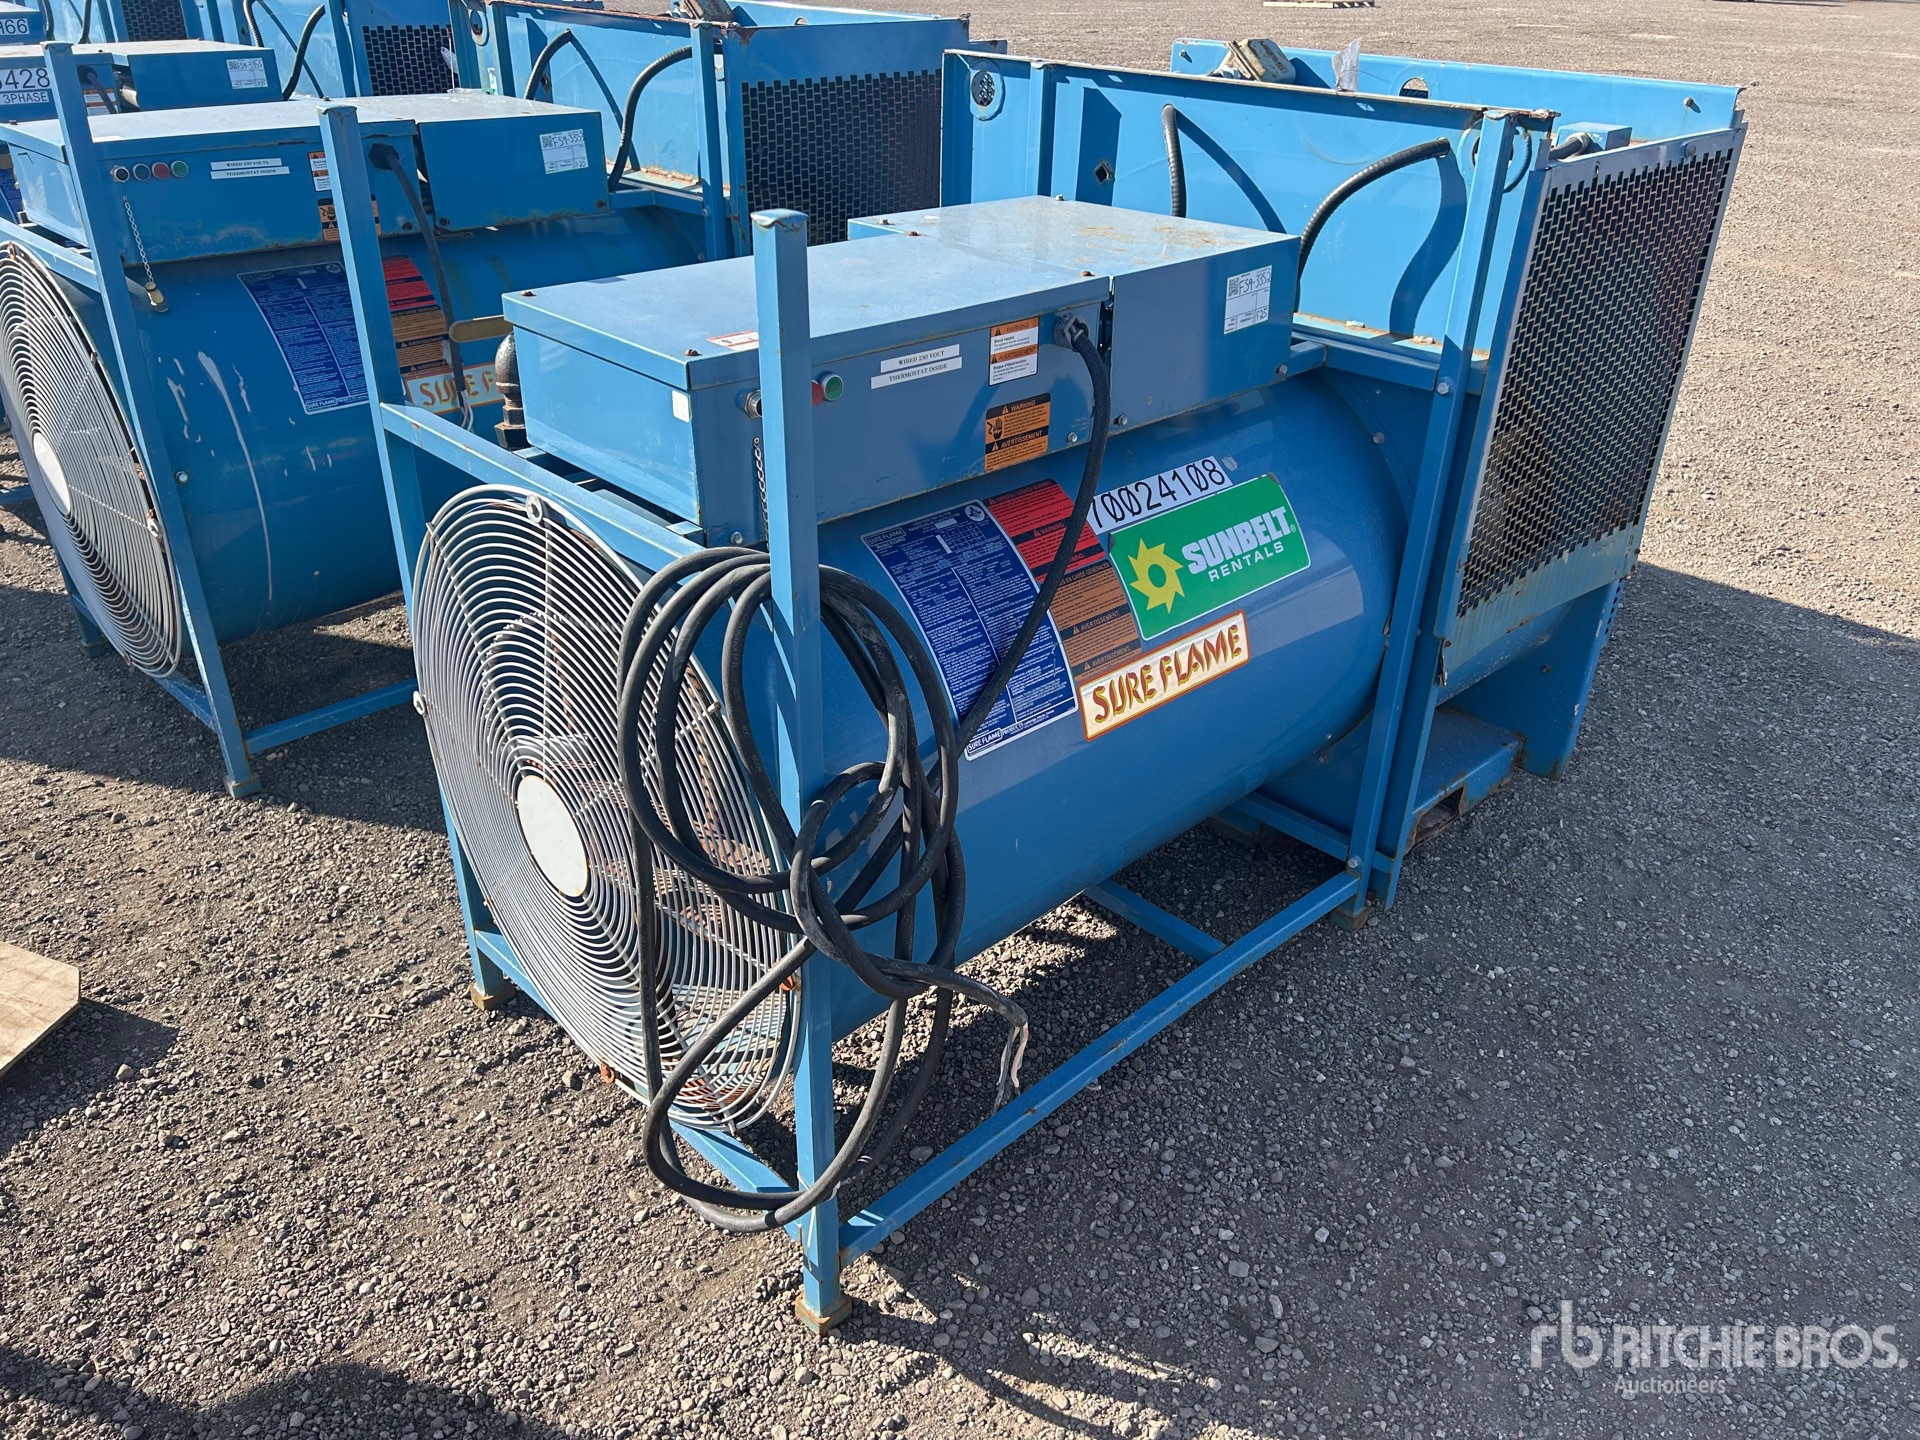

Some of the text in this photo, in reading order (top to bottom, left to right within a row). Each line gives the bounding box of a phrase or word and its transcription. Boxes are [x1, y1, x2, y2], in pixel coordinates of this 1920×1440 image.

[0, 68, 51, 89] 428
[3, 91, 48, 104] 3PHASE
[1006, 321, 1030, 332] WARNING
[898, 350, 945, 366] WIRED 230 VOLT
[999, 346, 1036, 361] AVERTISSEMENT
[889, 367, 928, 382] THERMOSTAT
[420, 374, 479, 406] SUE
[1011, 400, 1035, 412] WARNING
[1001, 431, 1042, 448] AVERTISSEMENT
[1182, 506, 1291, 574] SUNBELT
[1208, 541, 1284, 582] RENTALS
[1072, 571, 1086, 581] GARDE
[1093, 664, 1157, 723] SURE
[1159, 624, 1243, 693] FLAME
[967, 738, 982, 751] SURE
[982, 730, 1001, 745] FLAME
